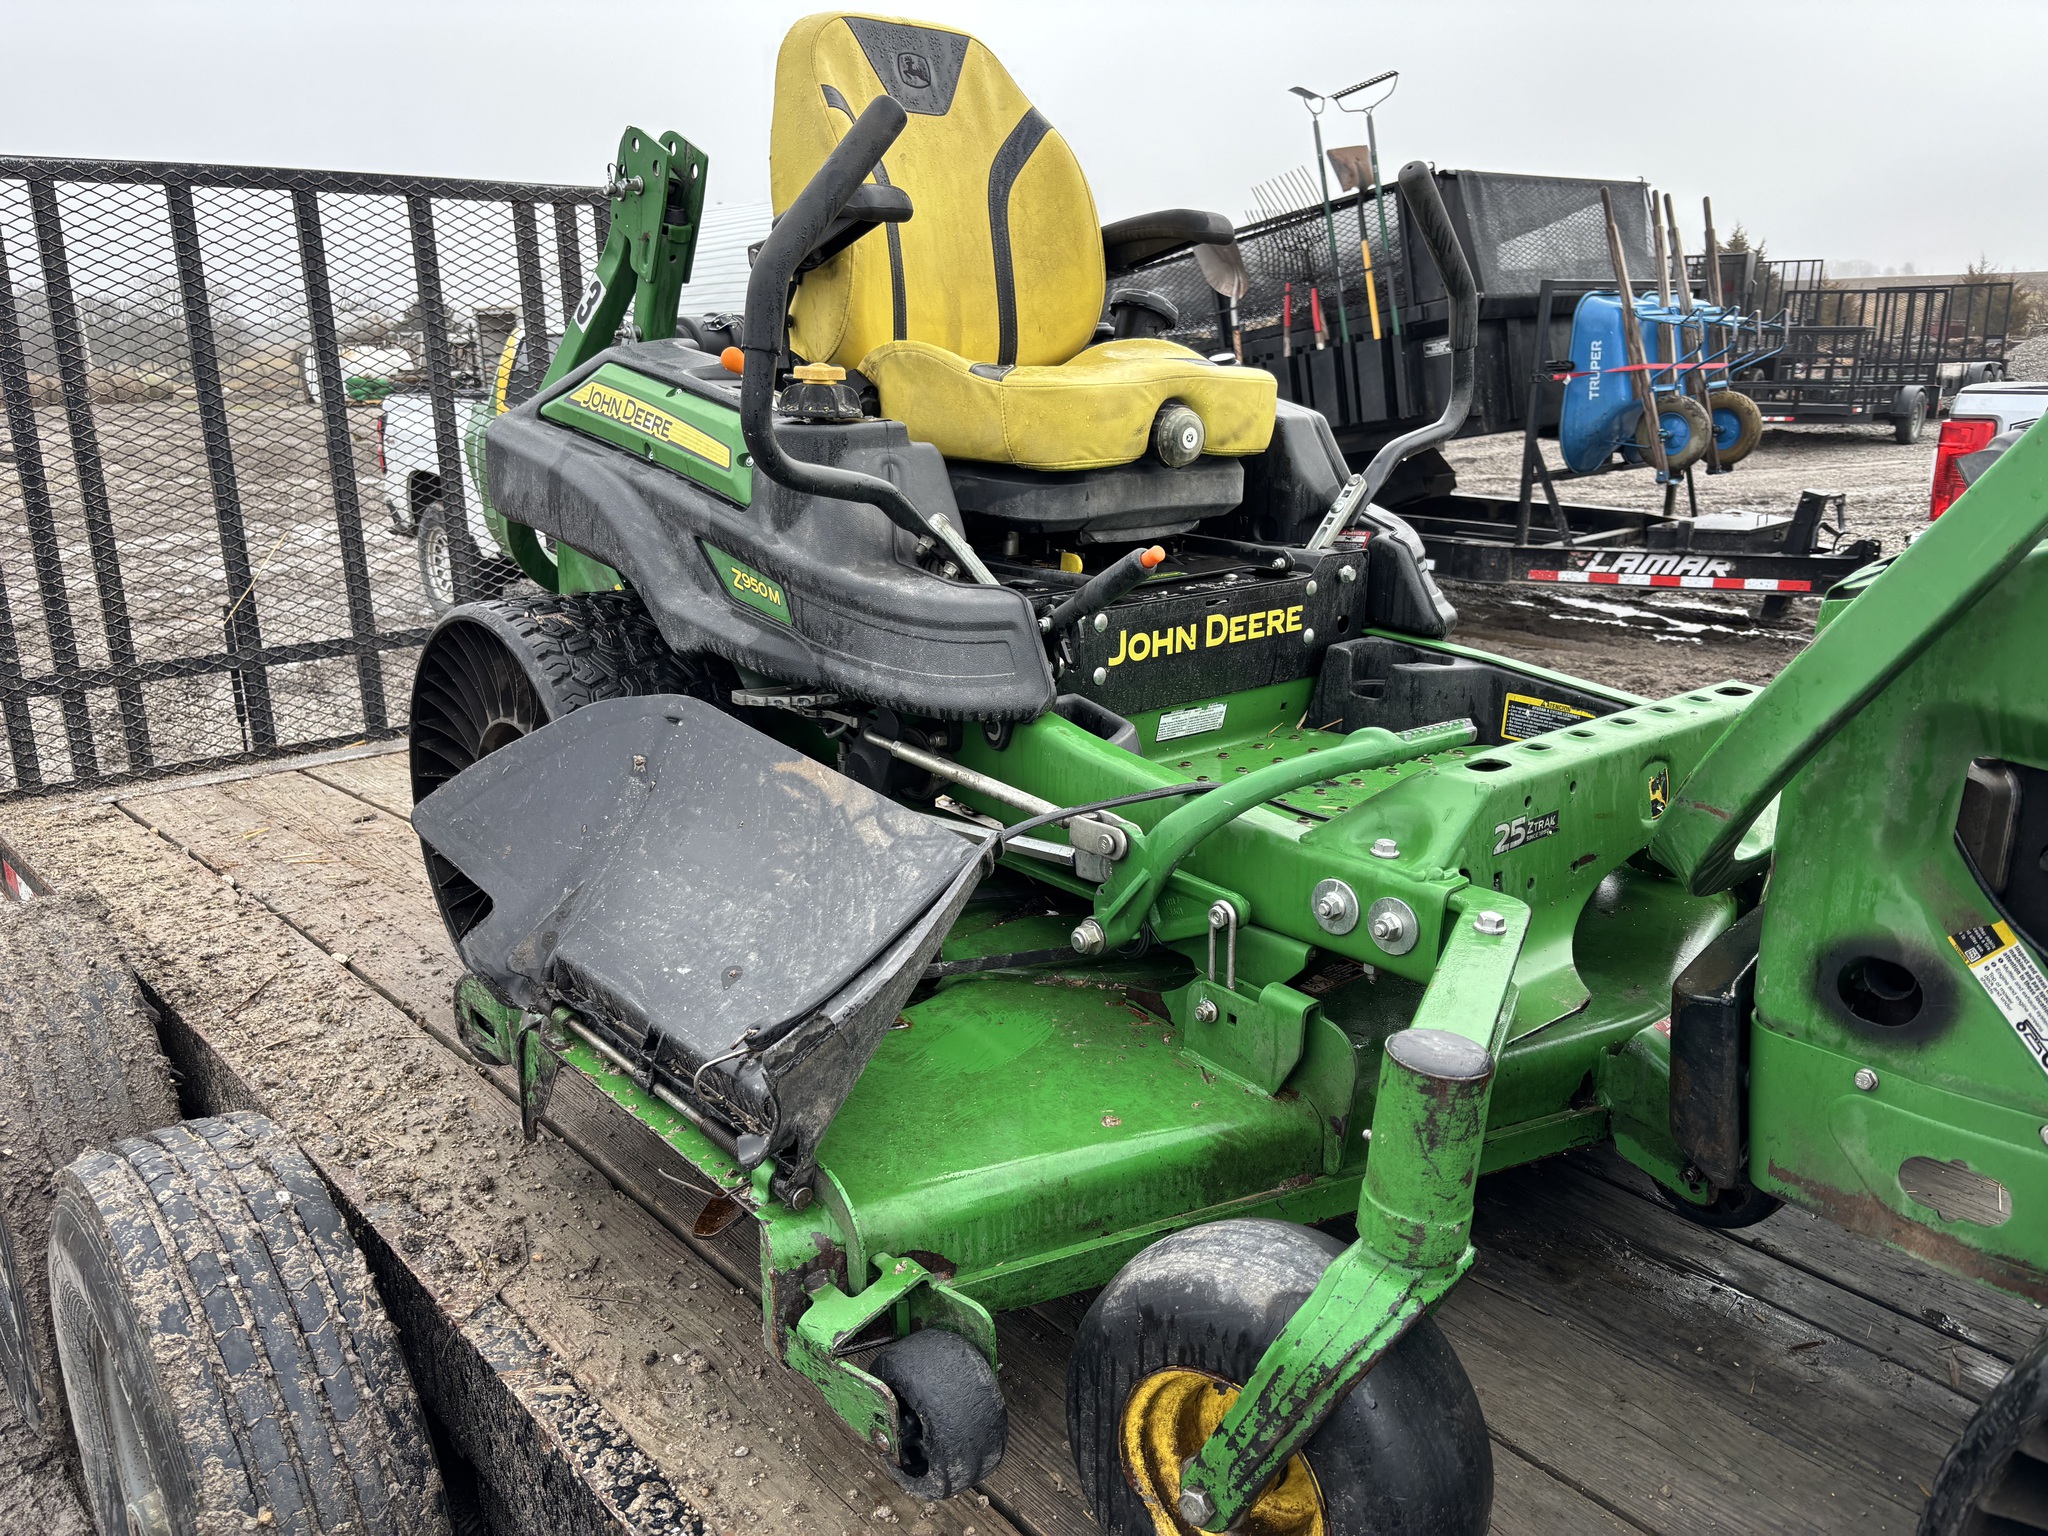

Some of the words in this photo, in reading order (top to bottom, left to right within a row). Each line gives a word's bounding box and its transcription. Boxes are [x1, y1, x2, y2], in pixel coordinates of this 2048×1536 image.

[576, 280, 602, 325] 3
[1588, 340, 1603, 401] TRUPER
[583, 386, 623, 415] JOHN
[623, 399, 673, 439] DEERE
[731, 566, 781, 606] Z950M
[1583, 552, 1732, 577] LAMAR
[1108, 623, 1197, 667] JOHN
[1206, 605, 1304, 648] DEERE
[1493, 816, 1526, 855] 25
[1527, 815, 1556, 834] ZTRAK
[1988, 972, 1997, 982] Top
[2002, 951, 2021, 974] attention
[2023, 980, 2036, 995] these
[2002, 963, 2016, 981] Muffler
[2014, 980, 2023, 991] and
[2021, 990, 2037, 1010] exhaust
[2008, 948, 2026, 971] machine
[2024, 971, 2033, 981] and
[2031, 981, 2040, 991] pay
[2013, 945, 2029, 964] Inspect
[2027, 964, 2037, 974] and
[2035, 974, 2047, 989] clean
[1992, 986, 2001, 996] and
[2000, 996, 2012, 1011] under
[1994, 967, 2010, 986] Engine
[2007, 985, 2017, 995] and
[2013, 994, 2029, 1013] engine
[2027, 1012, 2043, 1032] screens
